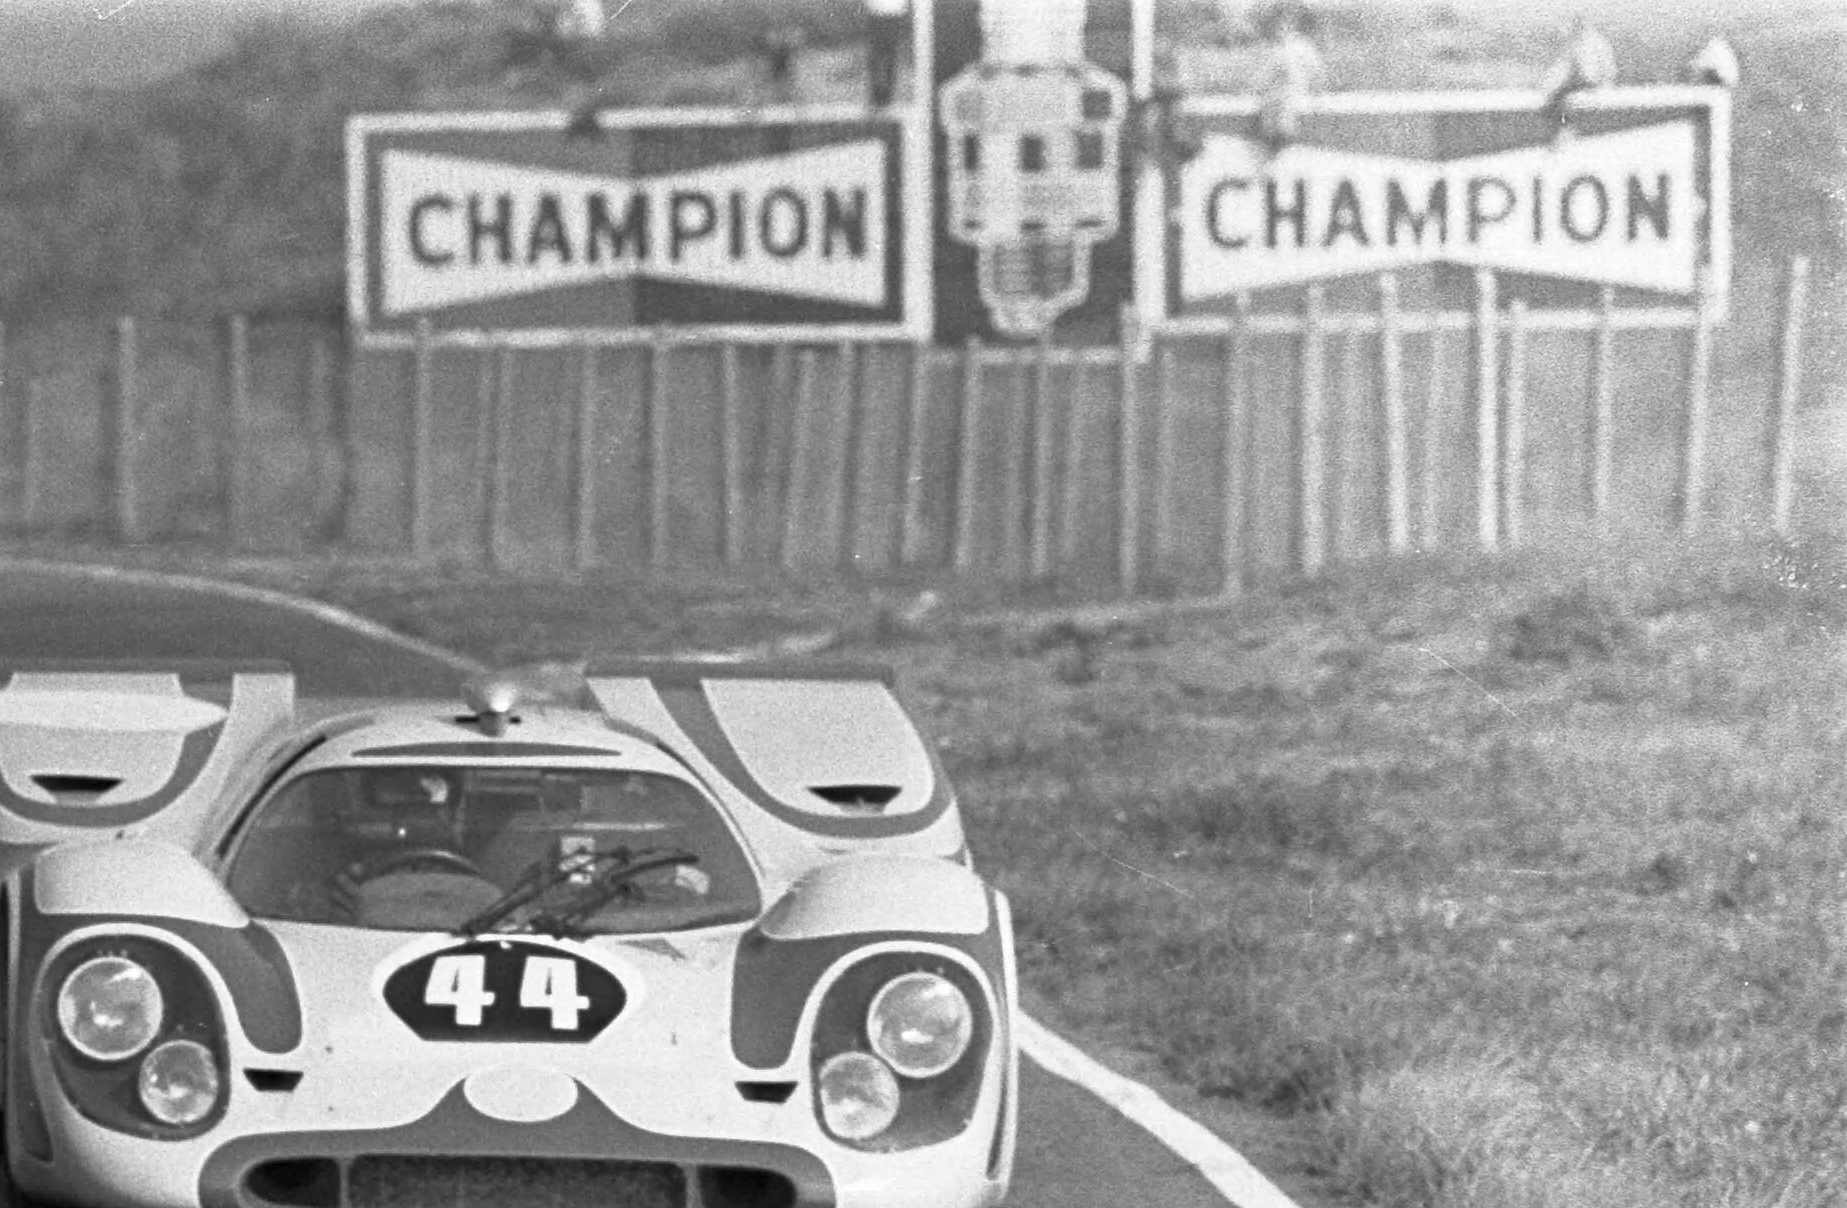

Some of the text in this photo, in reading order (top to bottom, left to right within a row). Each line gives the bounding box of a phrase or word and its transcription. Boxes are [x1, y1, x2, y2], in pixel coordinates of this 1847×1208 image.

[408, 187, 867, 267] CHAMPION
[1204, 172, 1671, 250] CHAMPION
[424, 953, 591, 1030] 44
